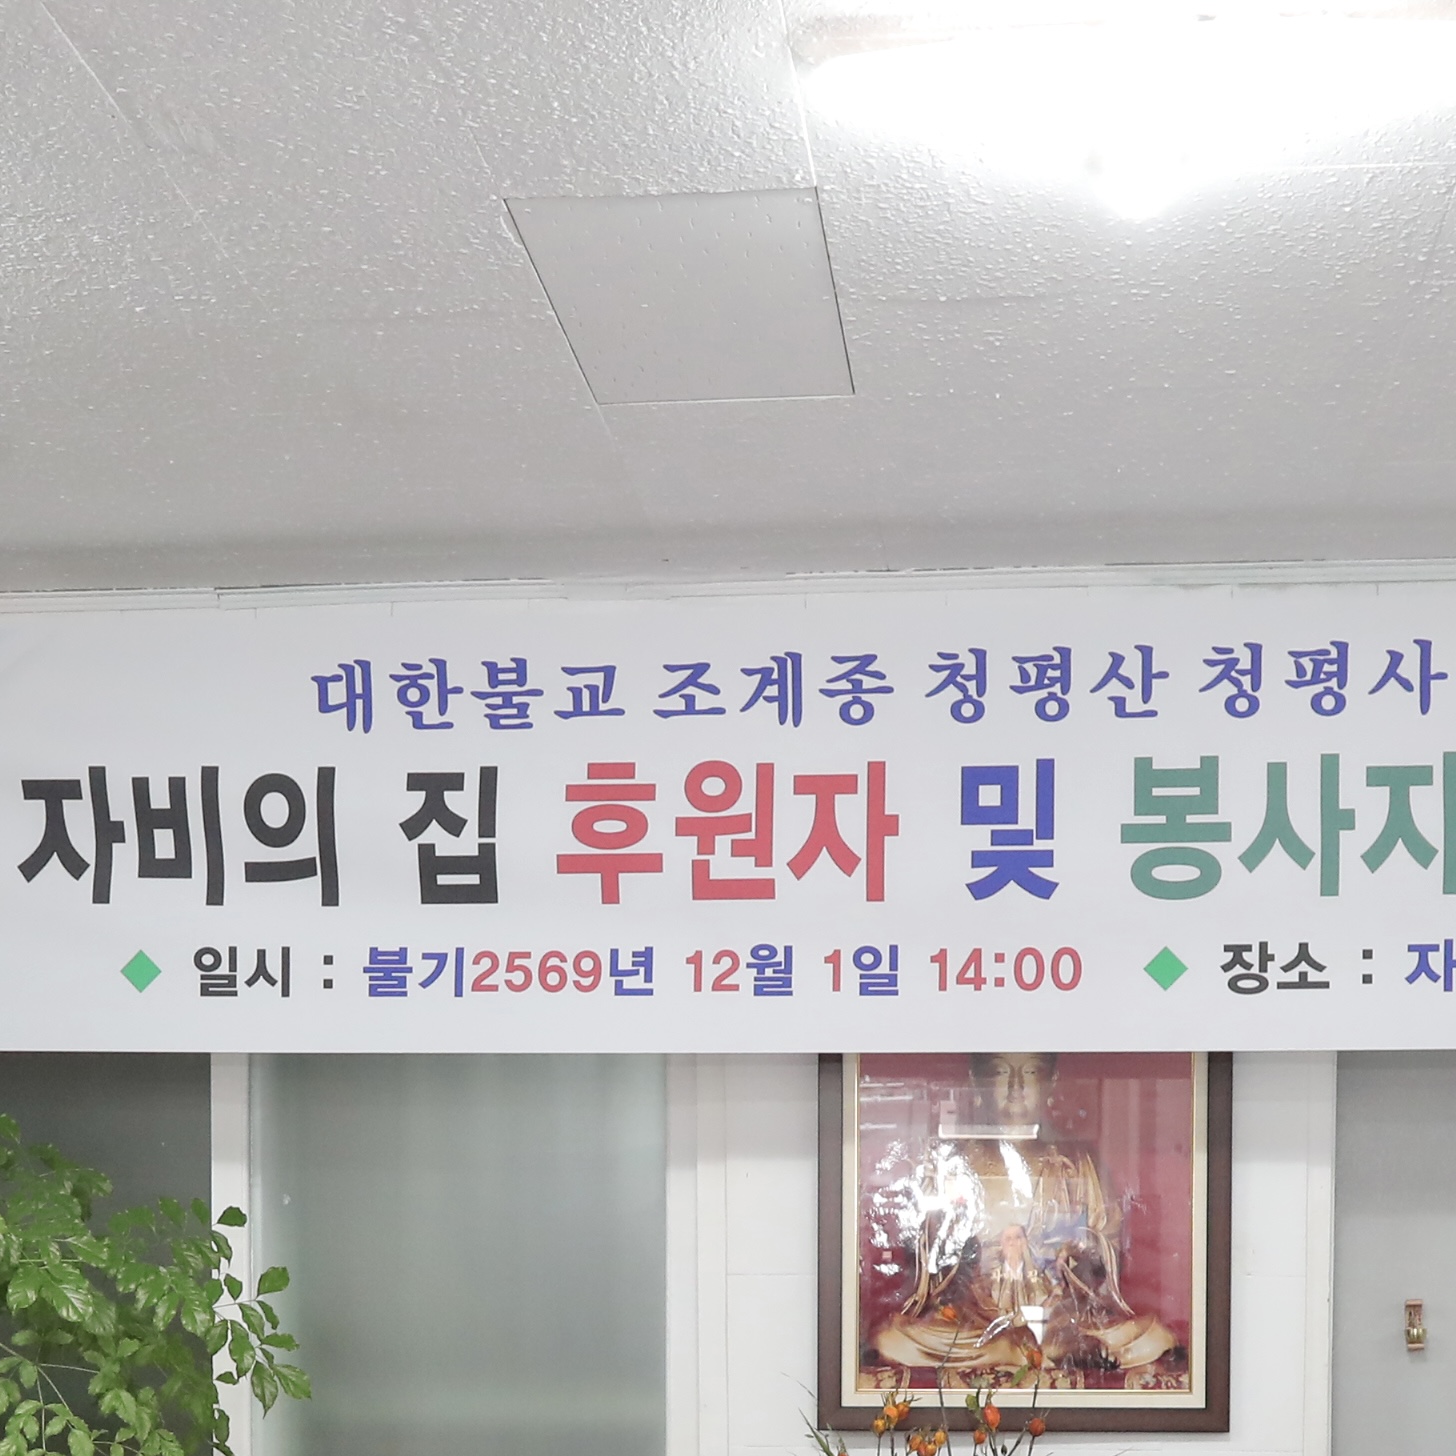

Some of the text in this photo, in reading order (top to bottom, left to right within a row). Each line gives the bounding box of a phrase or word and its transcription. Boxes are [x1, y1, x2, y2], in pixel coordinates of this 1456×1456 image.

[311, 639, 1448, 733] 대한불교 조계종 청평산 청평사
[18, 766, 339, 906] 자비의
[399, 766, 498, 904] 집
[557, 761, 899, 904] 후원자
[961, 759, 1059, 900] 및
[194, 946, 290, 997] 일시
[363, 947, 653, 997] 불기2569년
[686, 944, 793, 996] 12월
[824, 945, 898, 996] 1일
[931, 947, 1081, 991] 14:00
[1220, 941, 1329, 994] 장소
